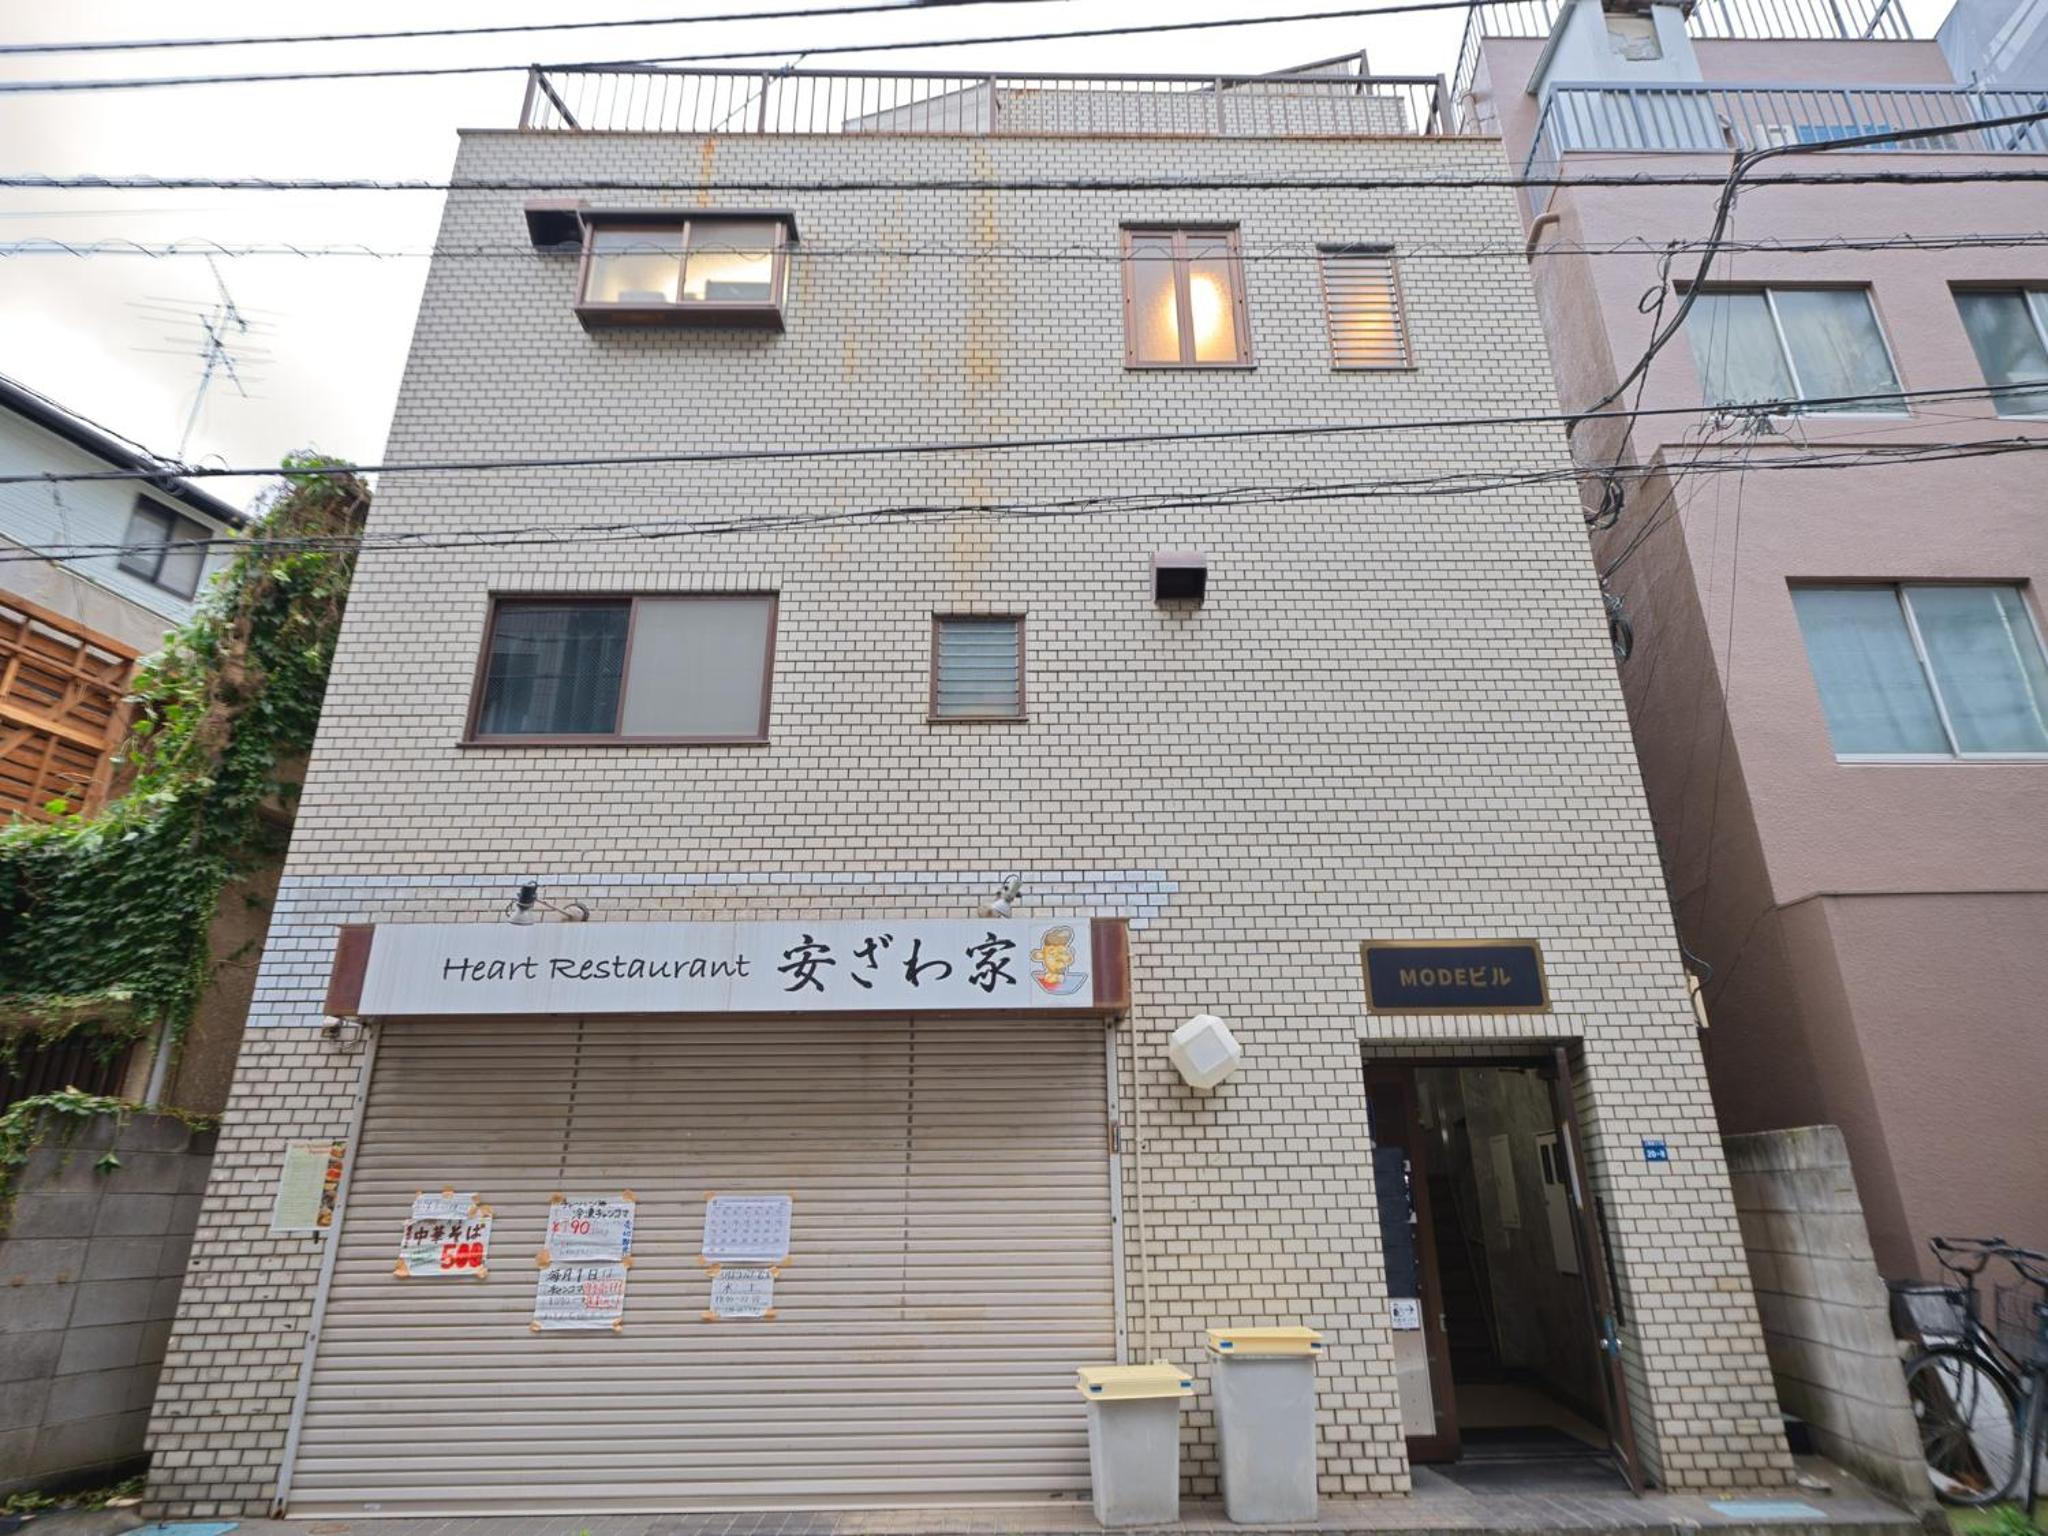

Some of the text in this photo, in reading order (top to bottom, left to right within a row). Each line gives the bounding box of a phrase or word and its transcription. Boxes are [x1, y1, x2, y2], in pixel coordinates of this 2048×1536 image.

[442, 952, 752, 982] Heart Restaurant
[776, 933, 1019, 993] 安ざわ家
[1399, 966, 1513, 988] MODEビル
